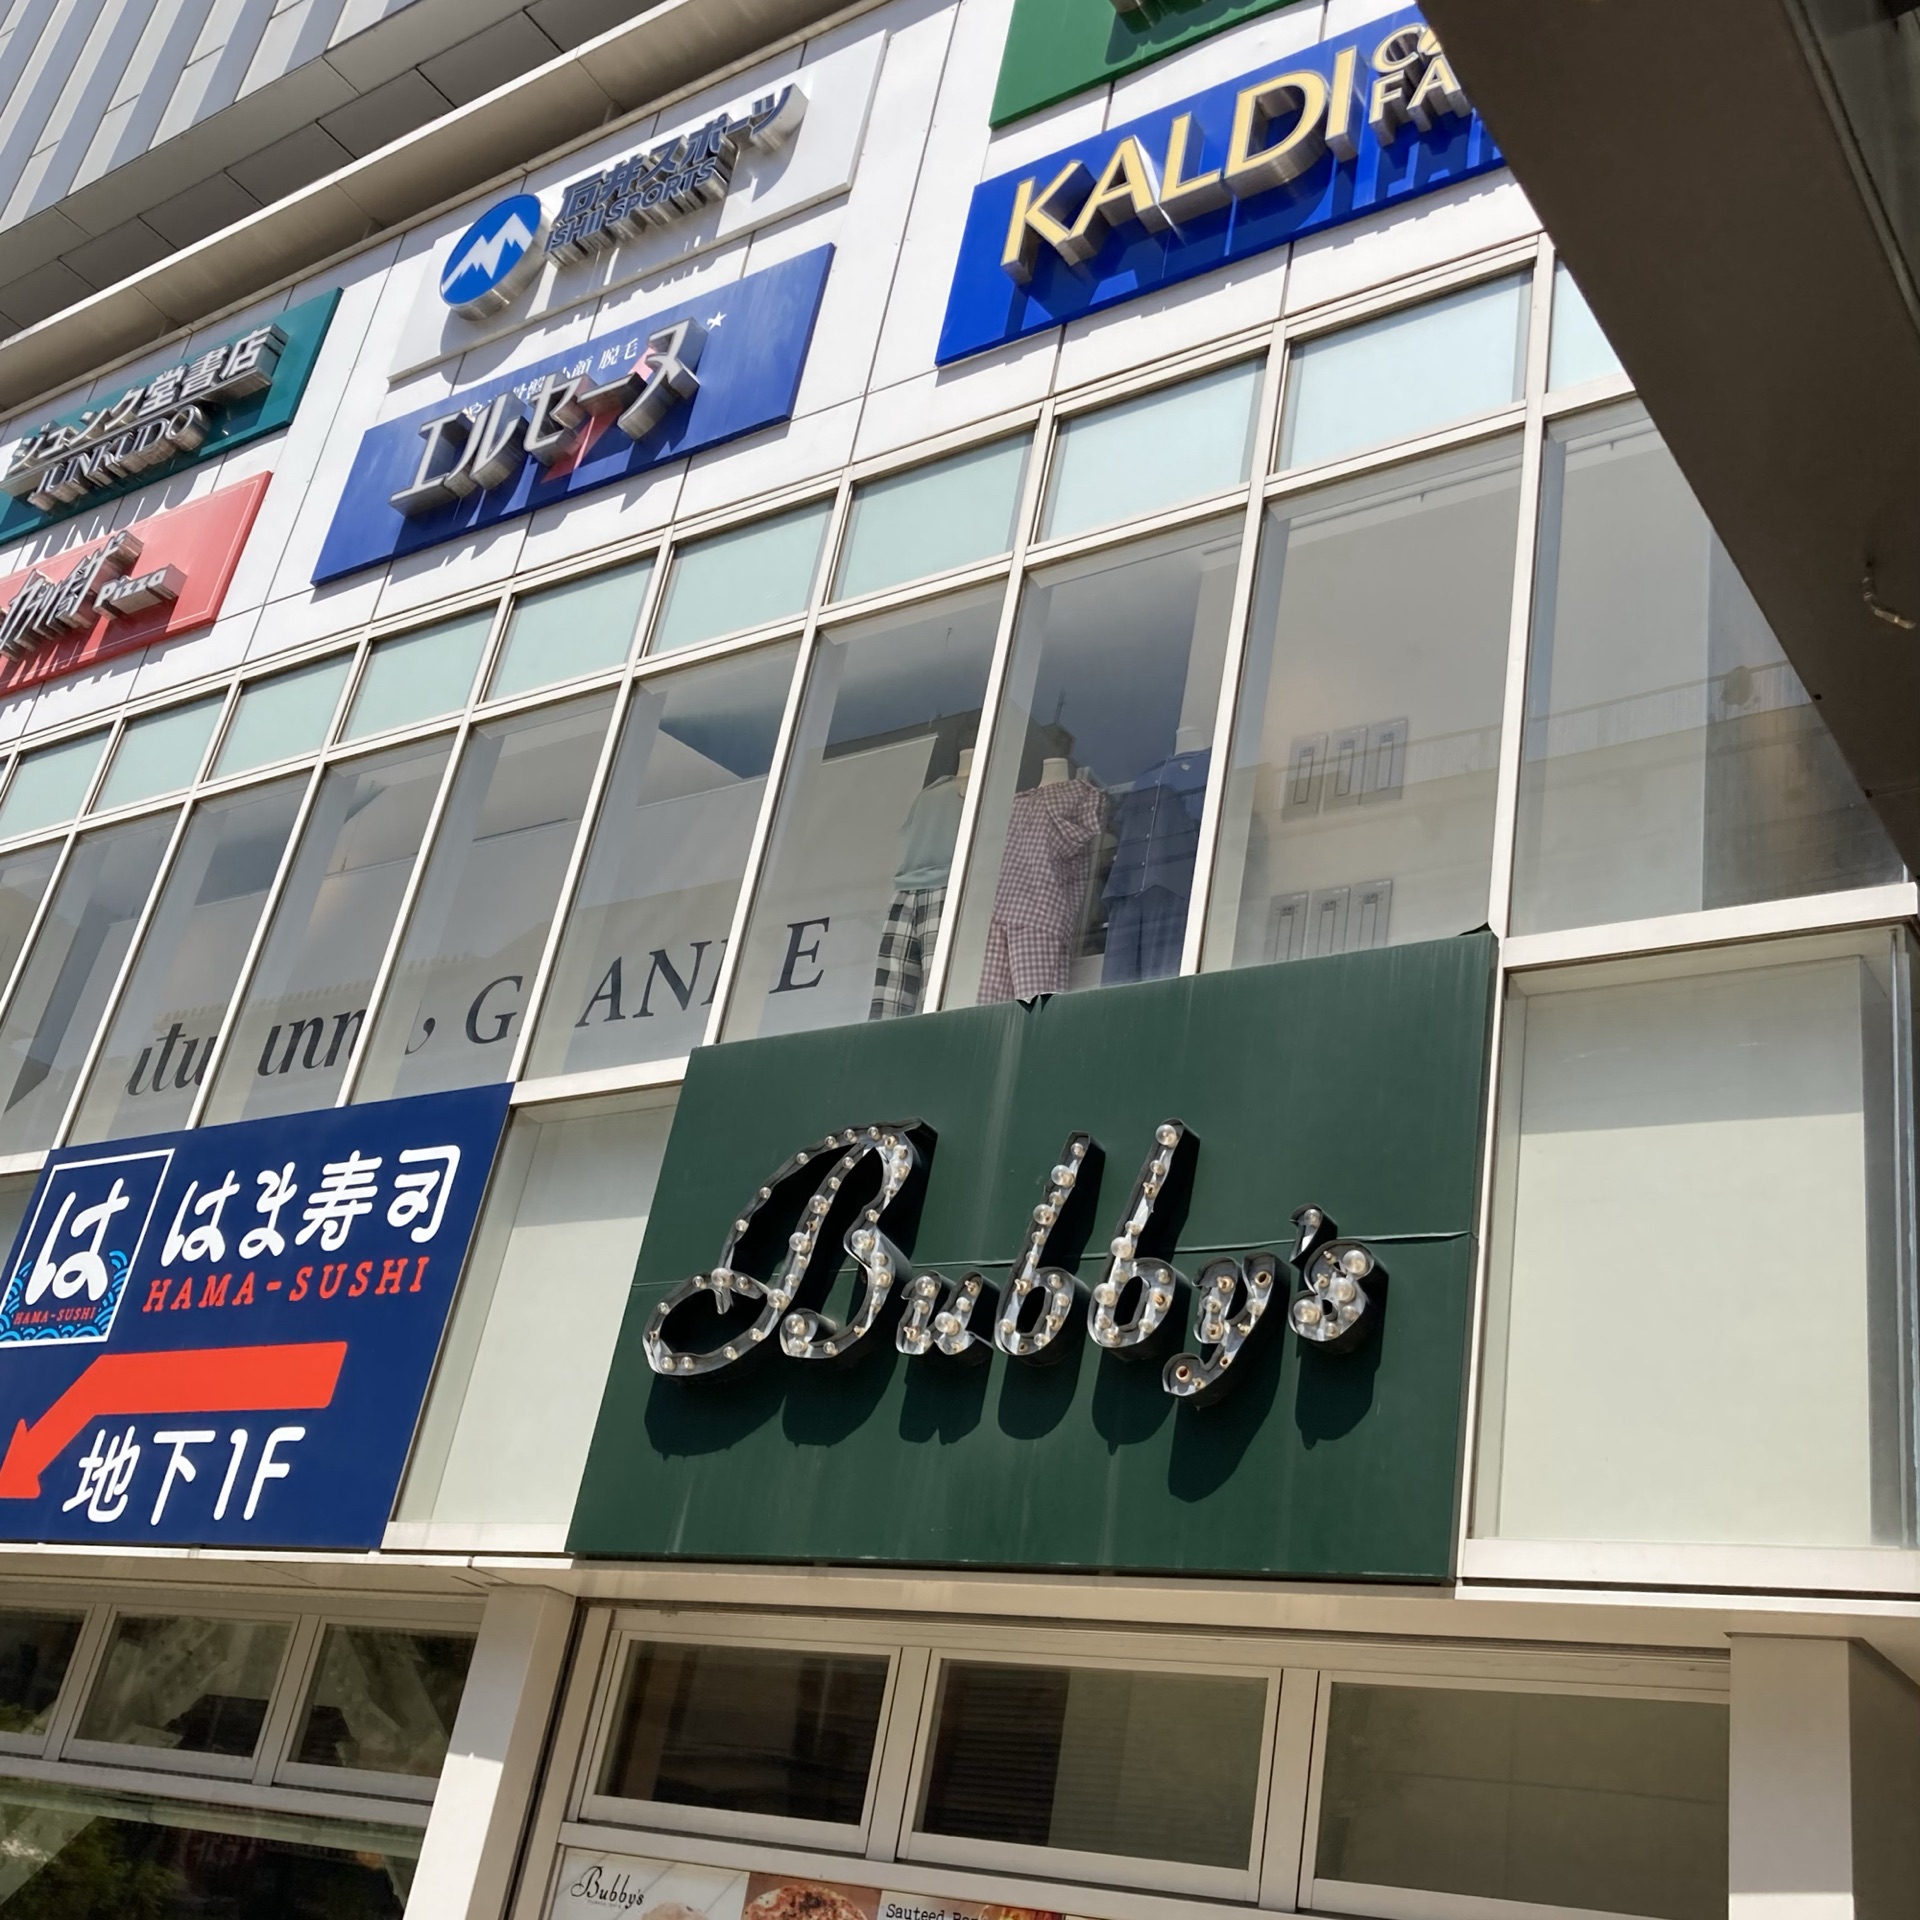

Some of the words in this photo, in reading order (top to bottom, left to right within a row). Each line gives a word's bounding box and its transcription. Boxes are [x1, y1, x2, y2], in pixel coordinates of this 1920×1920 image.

[555, 83, 793, 223] 石井スポーツ
[1000, 45, 1358, 267] KALDI
[543, 207, 605, 254] ISHII
[605, 156, 718, 227] SPORTS
[7, 323, 275, 474] ジュンク堂書店
[390, 317, 694, 504] エルセーヌ
[28, 403, 202, 504] JUNKUDO
[95, 567, 169, 608] Pizza
[26, 1177, 130, 1306] は
[160, 1144, 461, 1268] はま寿司
[142, 1256, 430, 1313] HAMA-SUSHI
[642, 1117, 1380, 1404] Bubby's
[13, 1306, 97, 1326] HAMA-SUSHI
[62, 1425, 306, 1526] 地下1F
[570, 1865, 645, 1910] Bubby's
[886, 1903, 945, 1920] Sauteed
